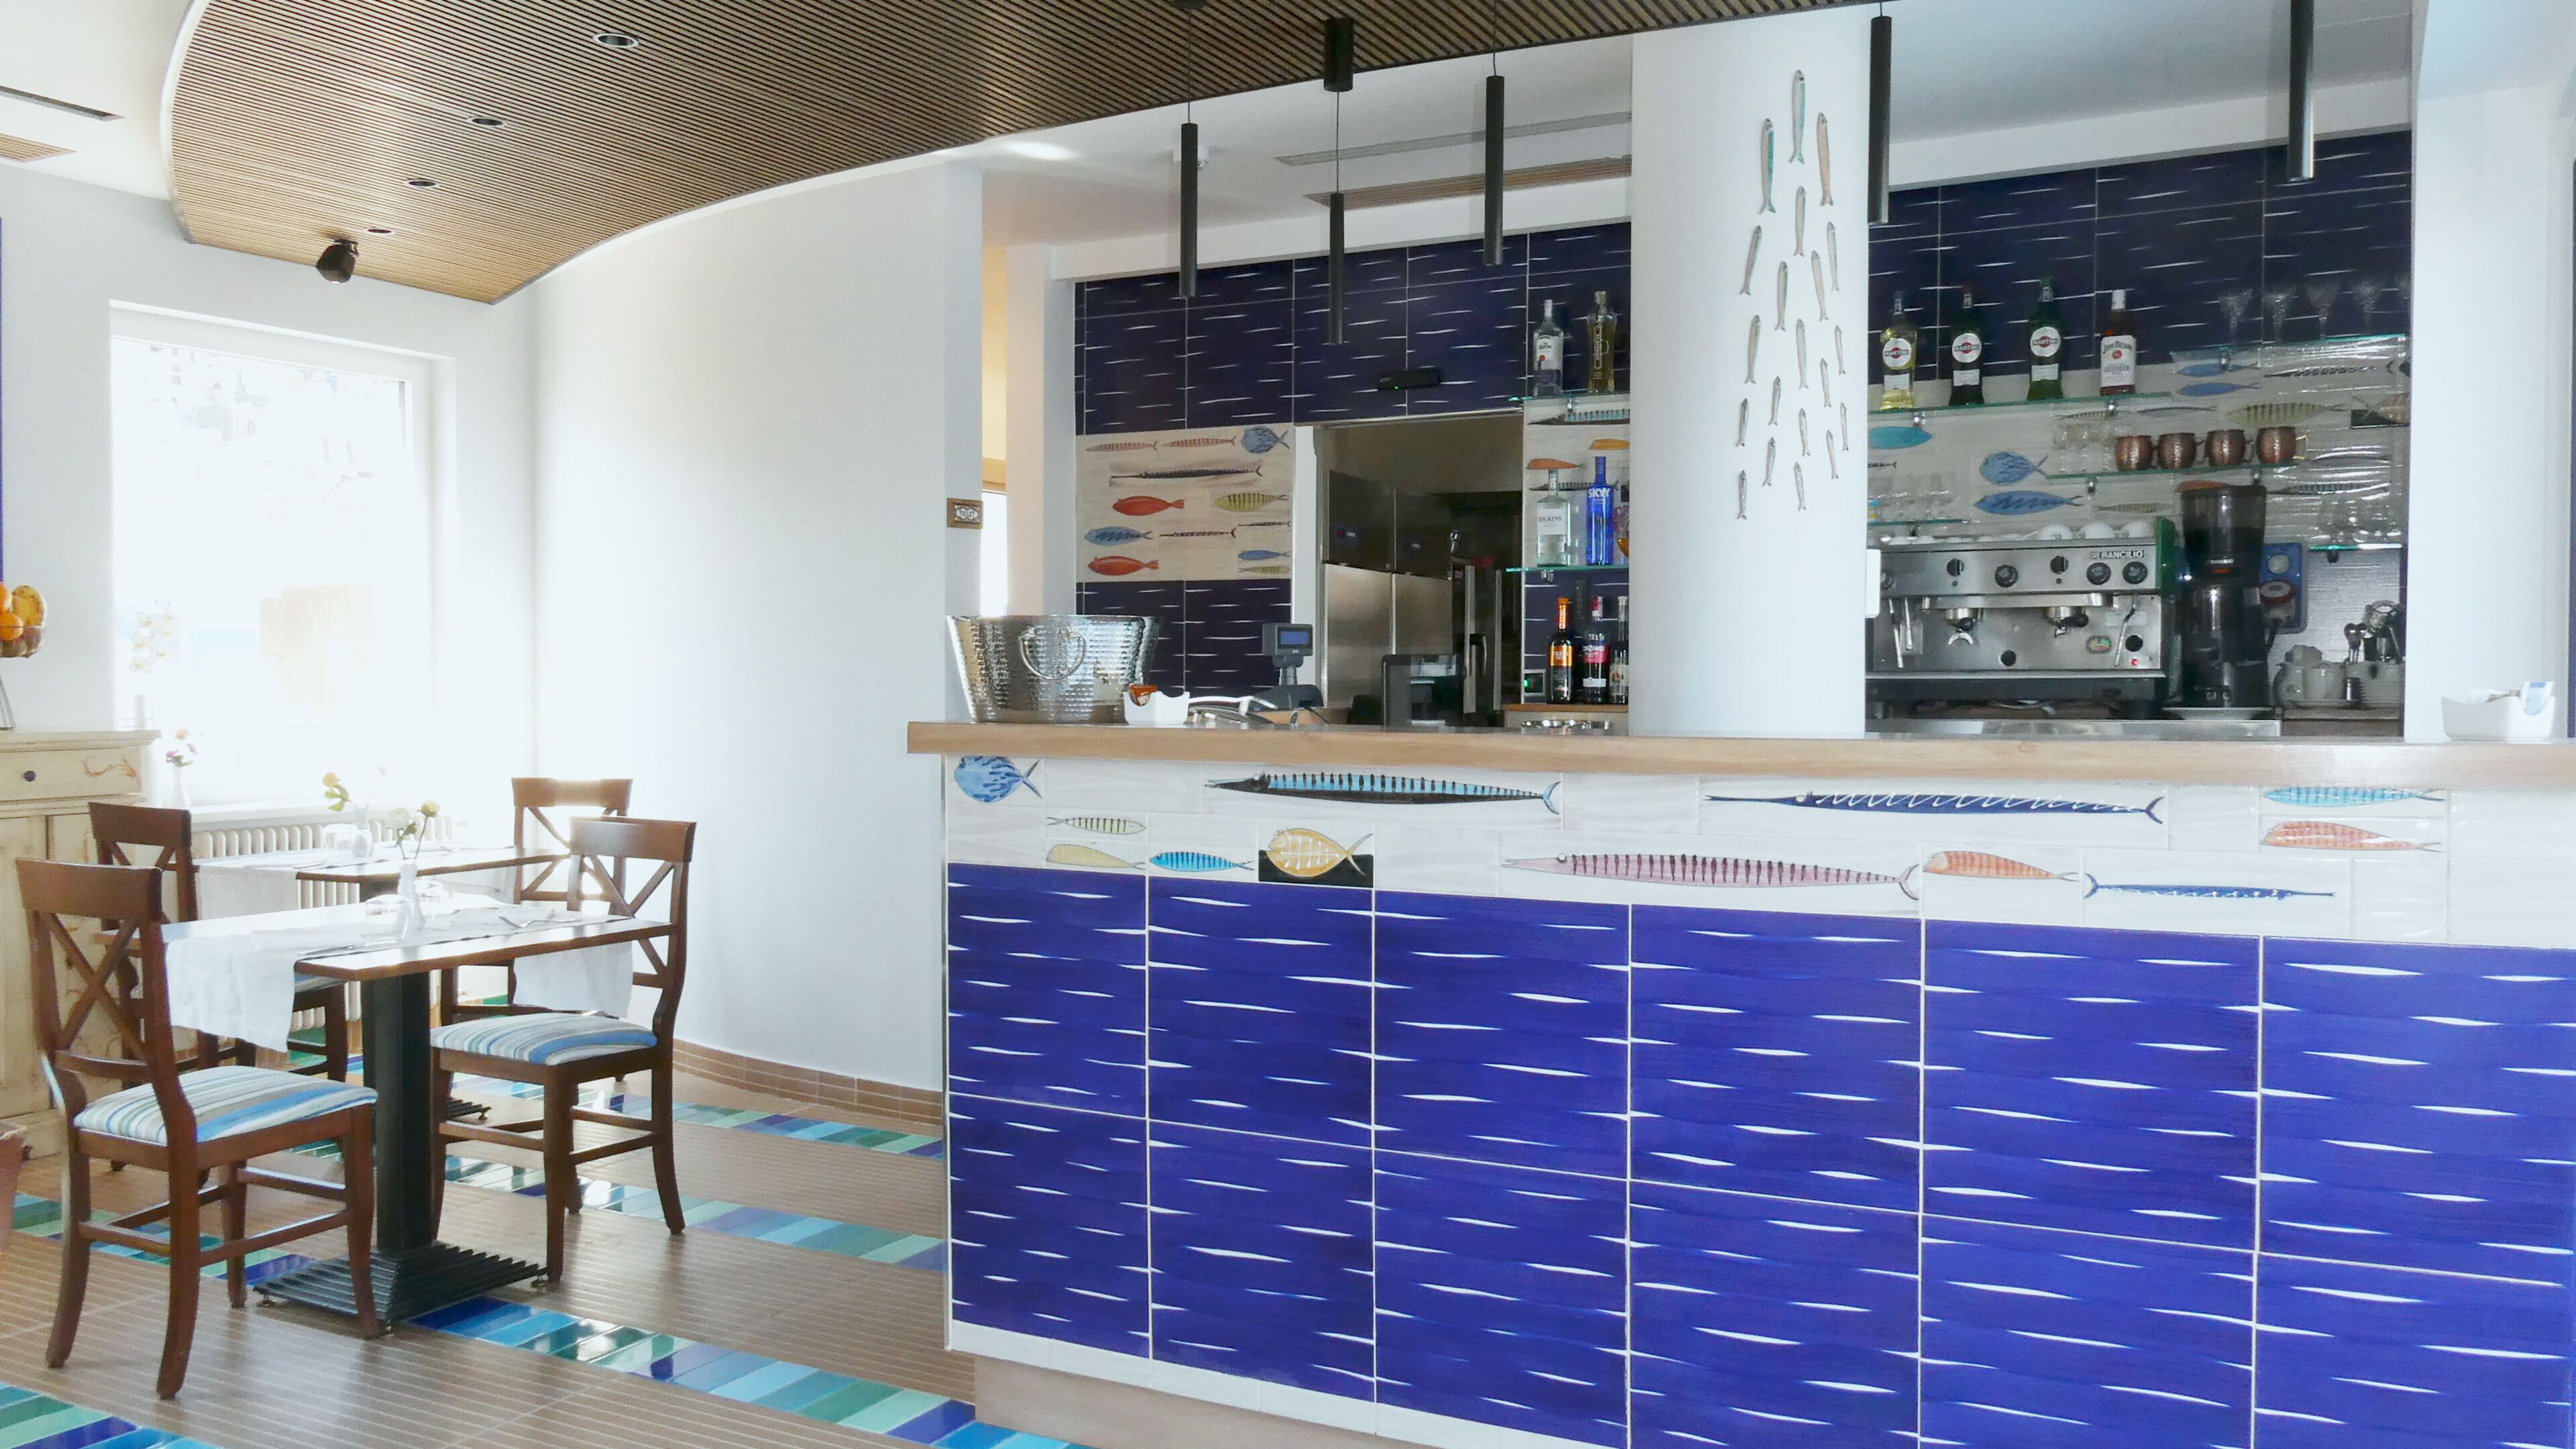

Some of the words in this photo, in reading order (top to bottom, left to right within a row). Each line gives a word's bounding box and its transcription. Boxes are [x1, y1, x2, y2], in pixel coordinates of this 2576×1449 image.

[2032, 337, 2059, 345] MARTINI
[1884, 349, 1910, 357] MARTINI
[1588, 488, 1611, 498] SKYY
[2100, 550, 2143, 559] RANCILIO
